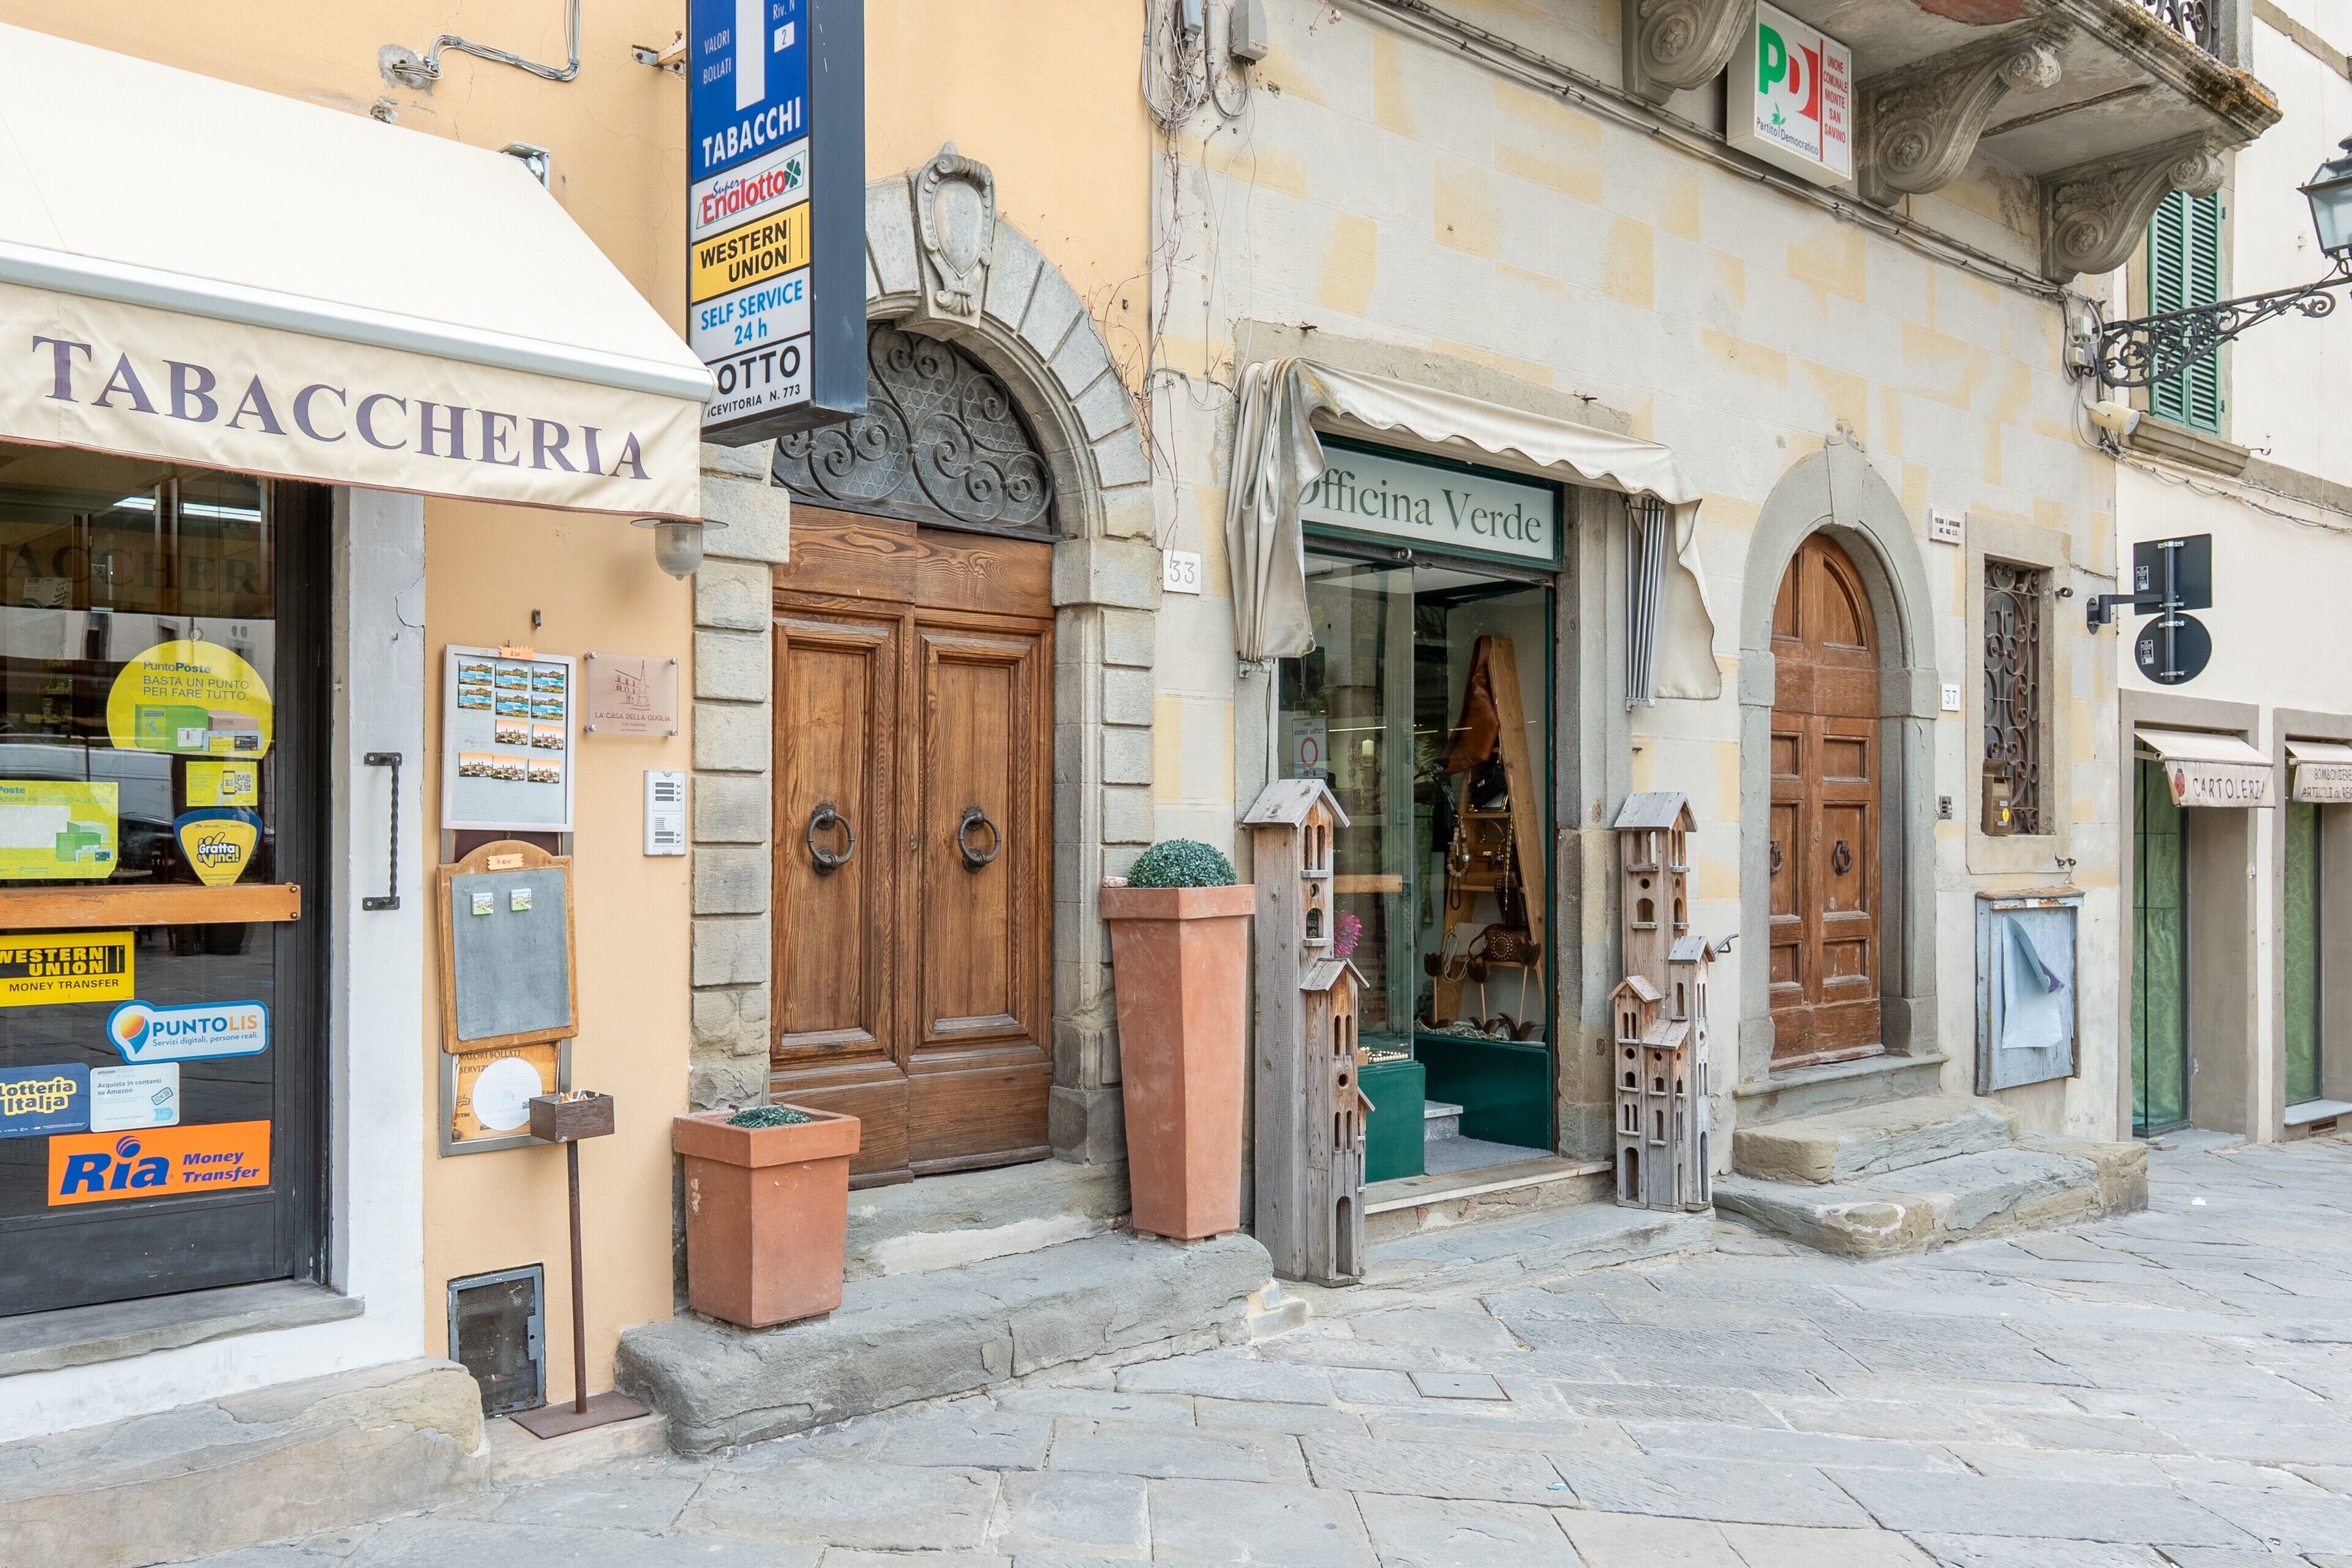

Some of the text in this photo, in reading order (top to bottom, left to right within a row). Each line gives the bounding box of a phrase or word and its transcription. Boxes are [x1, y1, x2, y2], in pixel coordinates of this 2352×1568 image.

[773, 4, 787, 20] Riv.
[704, 29, 729, 55] VALORI
[782, 29, 786, 45] 2
[703, 57, 731, 84] BOLLATI
[1826, 55, 1844, 74] UNIONE
[1823, 72, 1847, 93] COMUNALE
[1825, 88, 1845, 109] MONTE
[1828, 108, 1841, 124] SAN
[703, 96, 801, 167] TABACCHI
[1757, 117, 1819, 156] Partito Democratico
[1824, 123, 1846, 144] SAVINO
[701, 170, 786, 224] Enalotto
[712, 179, 741, 198] Super
[700, 219, 787, 269] WESTERN
[728, 244, 787, 282] UNION
[701, 279, 802, 331] SELF SERVICE
[734, 317, 767, 345] 24 h
[717, 345, 801, 395] OTTO
[769, 390, 780, 402] N.
[783, 383, 801, 398] 773
[32, 334, 652, 481] TABACCHERIA
[1441, 488, 1542, 543] Verde
[1170, 560, 1195, 584] 33
[143, 660, 211, 674] PuntoPoste
[143, 676, 249, 690] BASTA UN PUNTO
[143, 687, 249, 701] PER FARE TUTTO.
[1945, 690, 1957, 705] 37
[199, 843, 235, 854] Gratta
[0, 947, 104, 965] WESTERN
[29, 960, 104, 976] UNION
[9, 979, 119, 992] MONEY TRANSFER
[153, 1014, 258, 1037] PUNTOLIS
[153, 1031, 260, 1047] Servizi digitali, persone reali.
[460, 1049, 521, 1061] VALORI BOLLATI
[135, 1077, 162, 1086] contanti
[7, 1095, 65, 1112] Italia
[59, 1136, 244, 1195] Ria Money
[183, 1166, 260, 1183] Transfer
